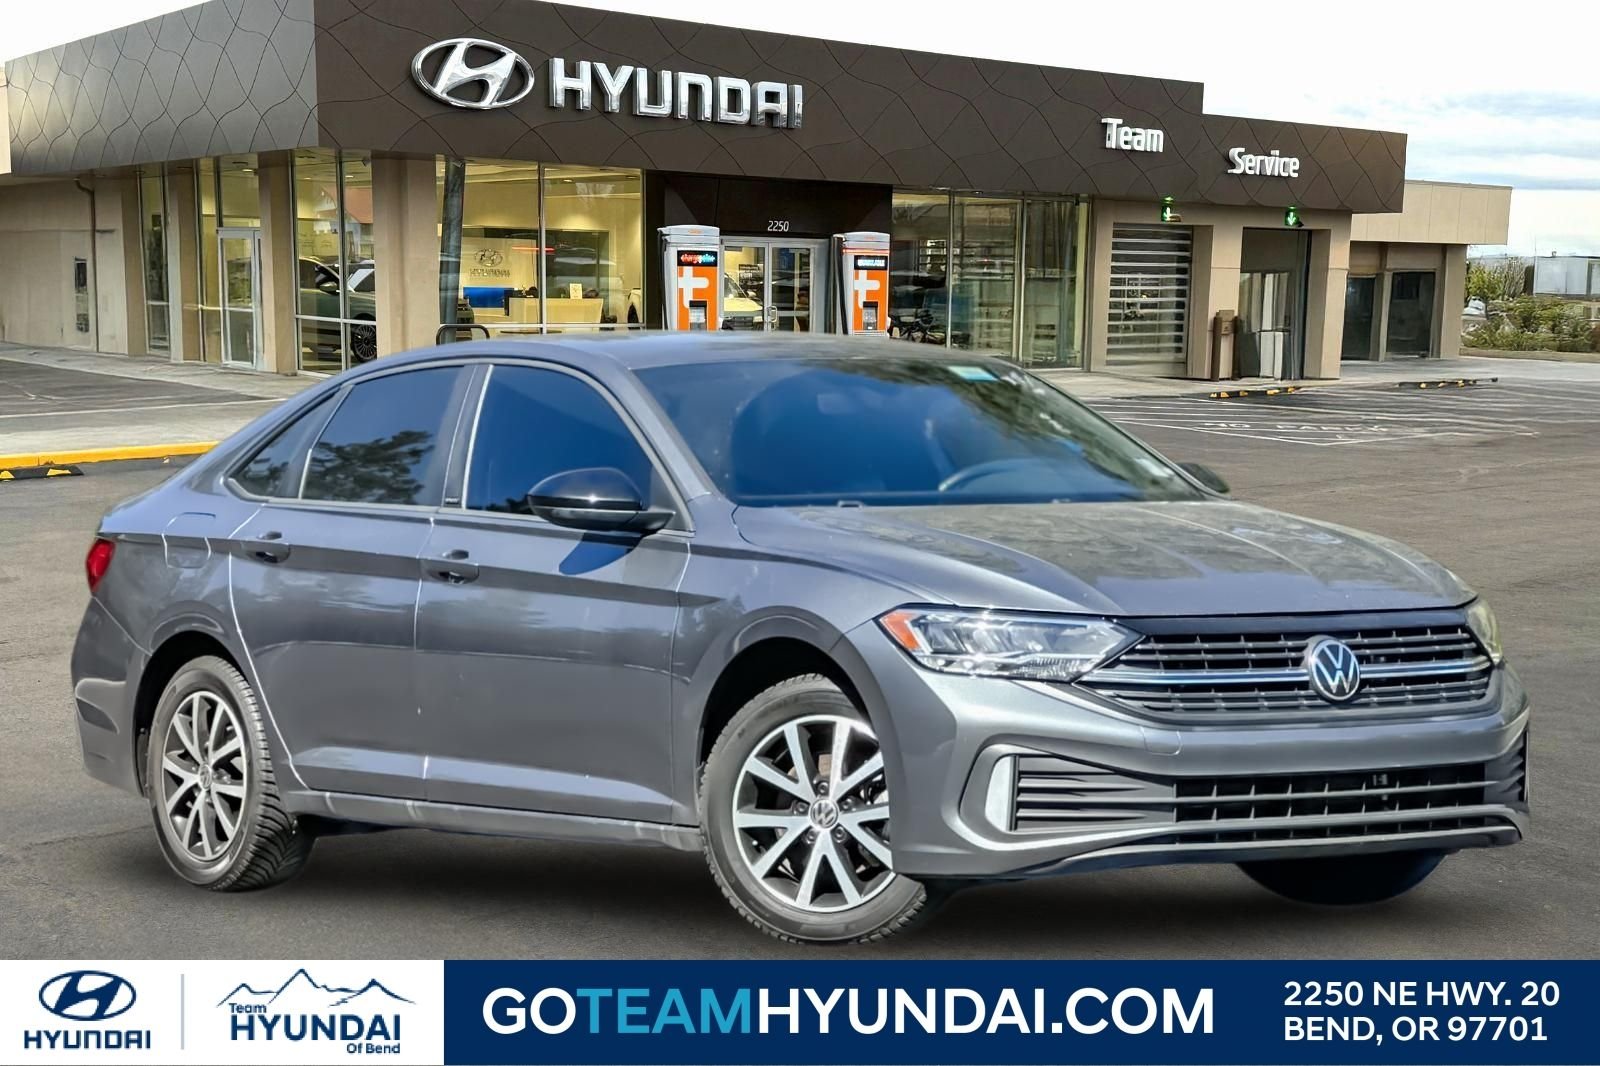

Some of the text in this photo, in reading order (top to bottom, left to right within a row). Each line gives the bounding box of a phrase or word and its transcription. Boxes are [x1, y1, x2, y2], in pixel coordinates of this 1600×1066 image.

[548, 57, 804, 129] HYUNDAI
[1101, 117, 1164, 153] Team
[1228, 147, 1300, 178] Service
[768, 221, 789, 231] 2250
